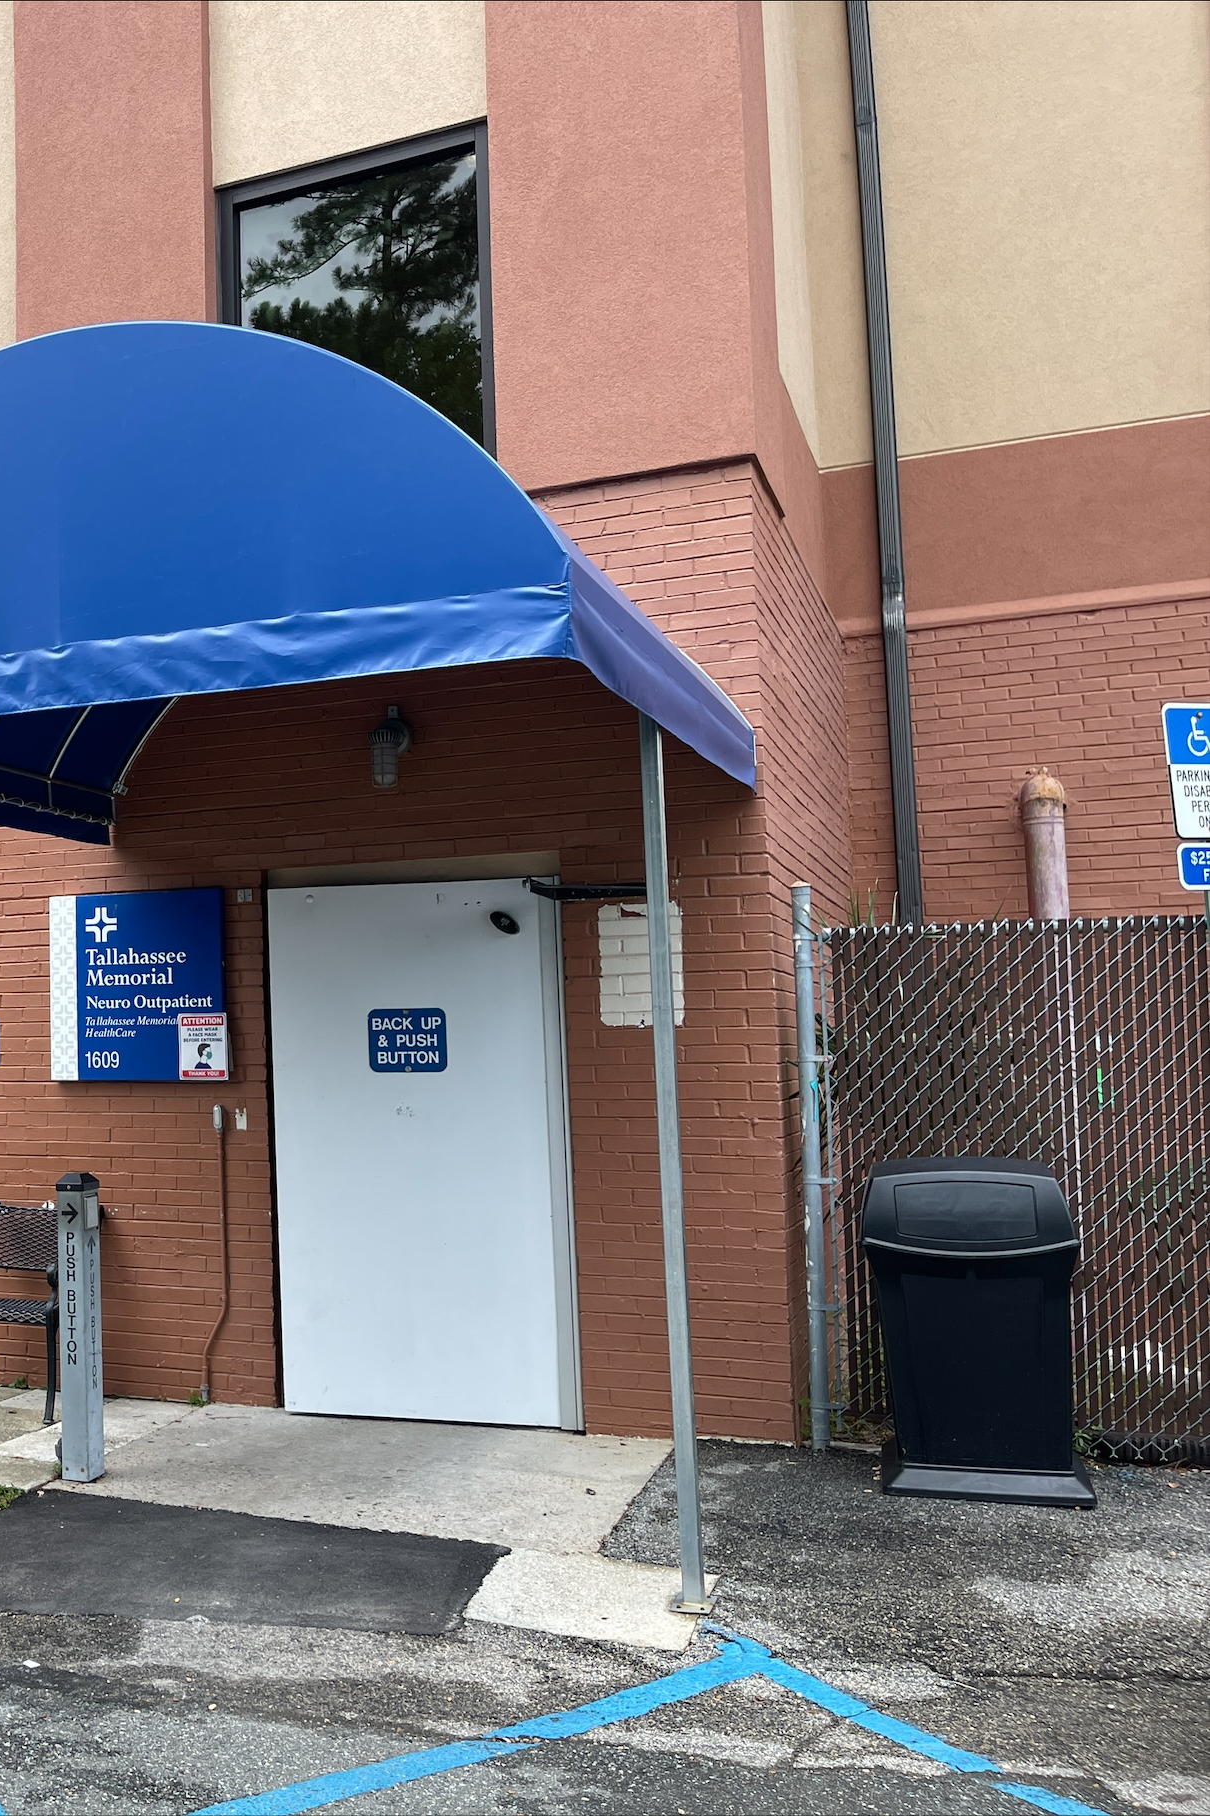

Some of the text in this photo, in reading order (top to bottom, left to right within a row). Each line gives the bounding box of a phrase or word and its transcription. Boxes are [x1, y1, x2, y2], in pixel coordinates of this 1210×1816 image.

[1176, 769, 1210, 783] PARKIN
[1184, 784, 1210, 798] DISAB
[1191, 800, 1210, 813] PER
[1198, 815, 1210, 829] ON
[1190, 850, 1210, 866] $25
[85, 947, 187, 966] Tallahassee
[85, 967, 174, 986] Memorial
[86, 994, 213, 1013] Neuro Outpatient
[85, 1016, 135, 1026] Tallahassee
[182, 1017, 223, 1025] ATTENTION
[371, 1016, 442, 1031] BACK UP
[85, 1027, 137, 1038] HealthCare
[377, 1033, 438, 1047] & PUSH
[85, 1051, 120, 1069] 1609
[377, 1051, 440, 1065] BUTTON
[66, 1231, 77, 1366] PUSH BUTTON
[90, 1316, 98, 1390] BUTTON
